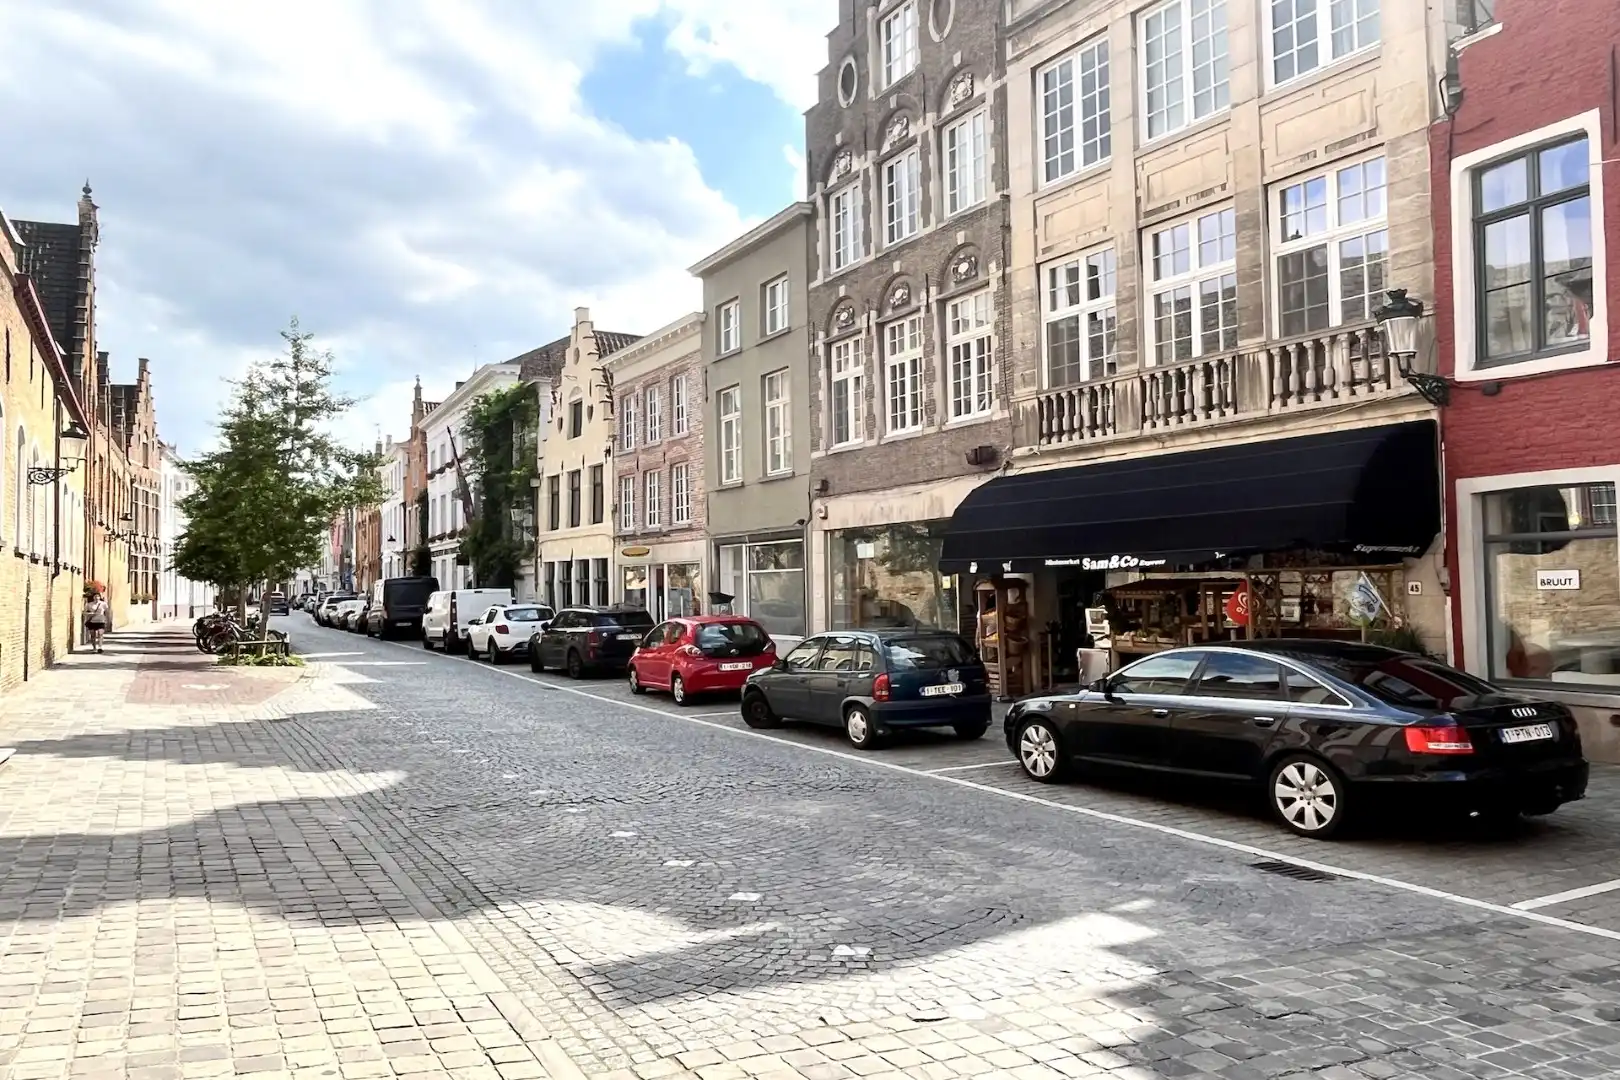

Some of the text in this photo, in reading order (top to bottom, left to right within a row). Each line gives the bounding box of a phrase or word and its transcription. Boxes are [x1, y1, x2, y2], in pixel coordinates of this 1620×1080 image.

[1082, 555, 1139, 570] Sam&Co
[1540, 578, 1573, 586] BRUUT
[1409, 584, 1420, 593] 45
